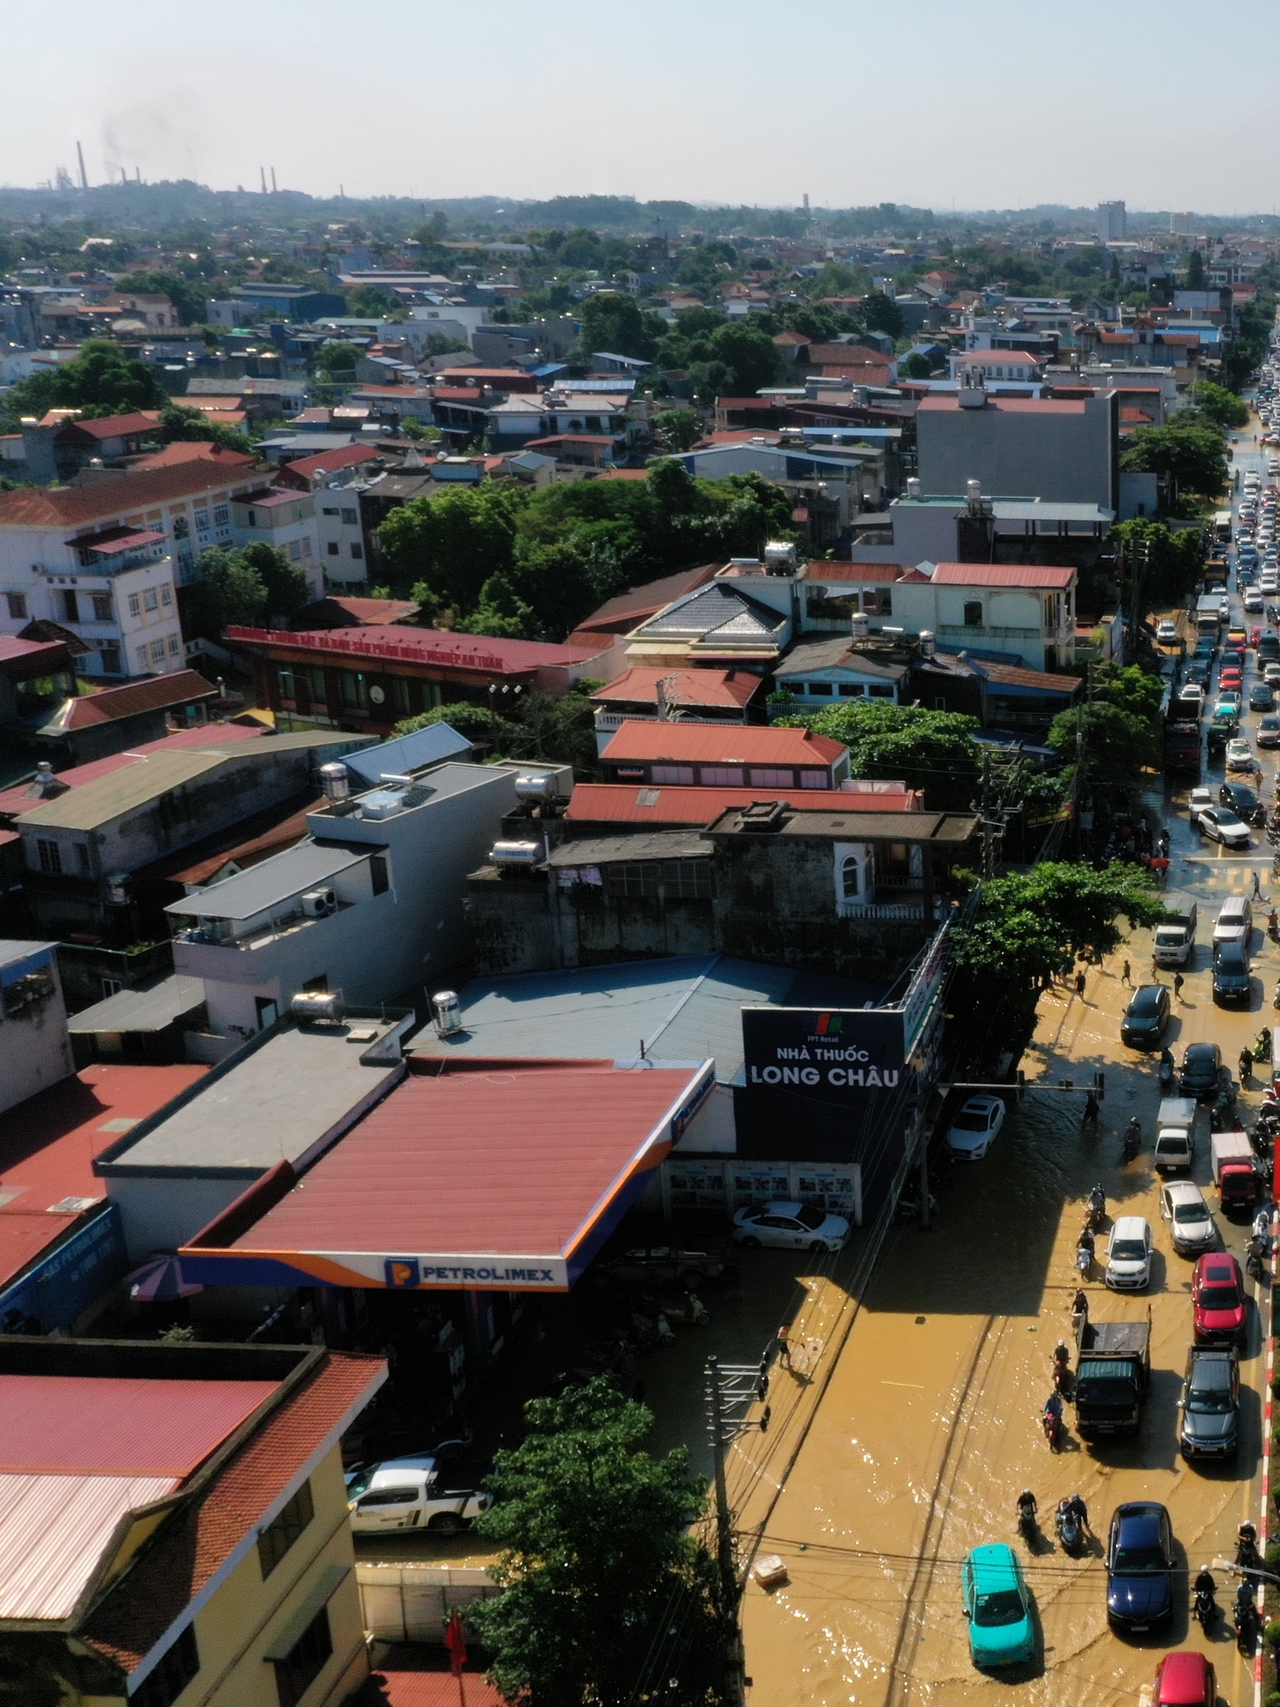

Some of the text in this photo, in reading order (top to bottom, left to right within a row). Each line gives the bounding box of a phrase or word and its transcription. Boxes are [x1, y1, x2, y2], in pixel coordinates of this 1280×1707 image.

[777, 1045, 869, 1062] NHÀ THUỐC
[751, 1065, 899, 1087] LONG CHÂU
[423, 1266, 554, 1282] PETROLIMEX
